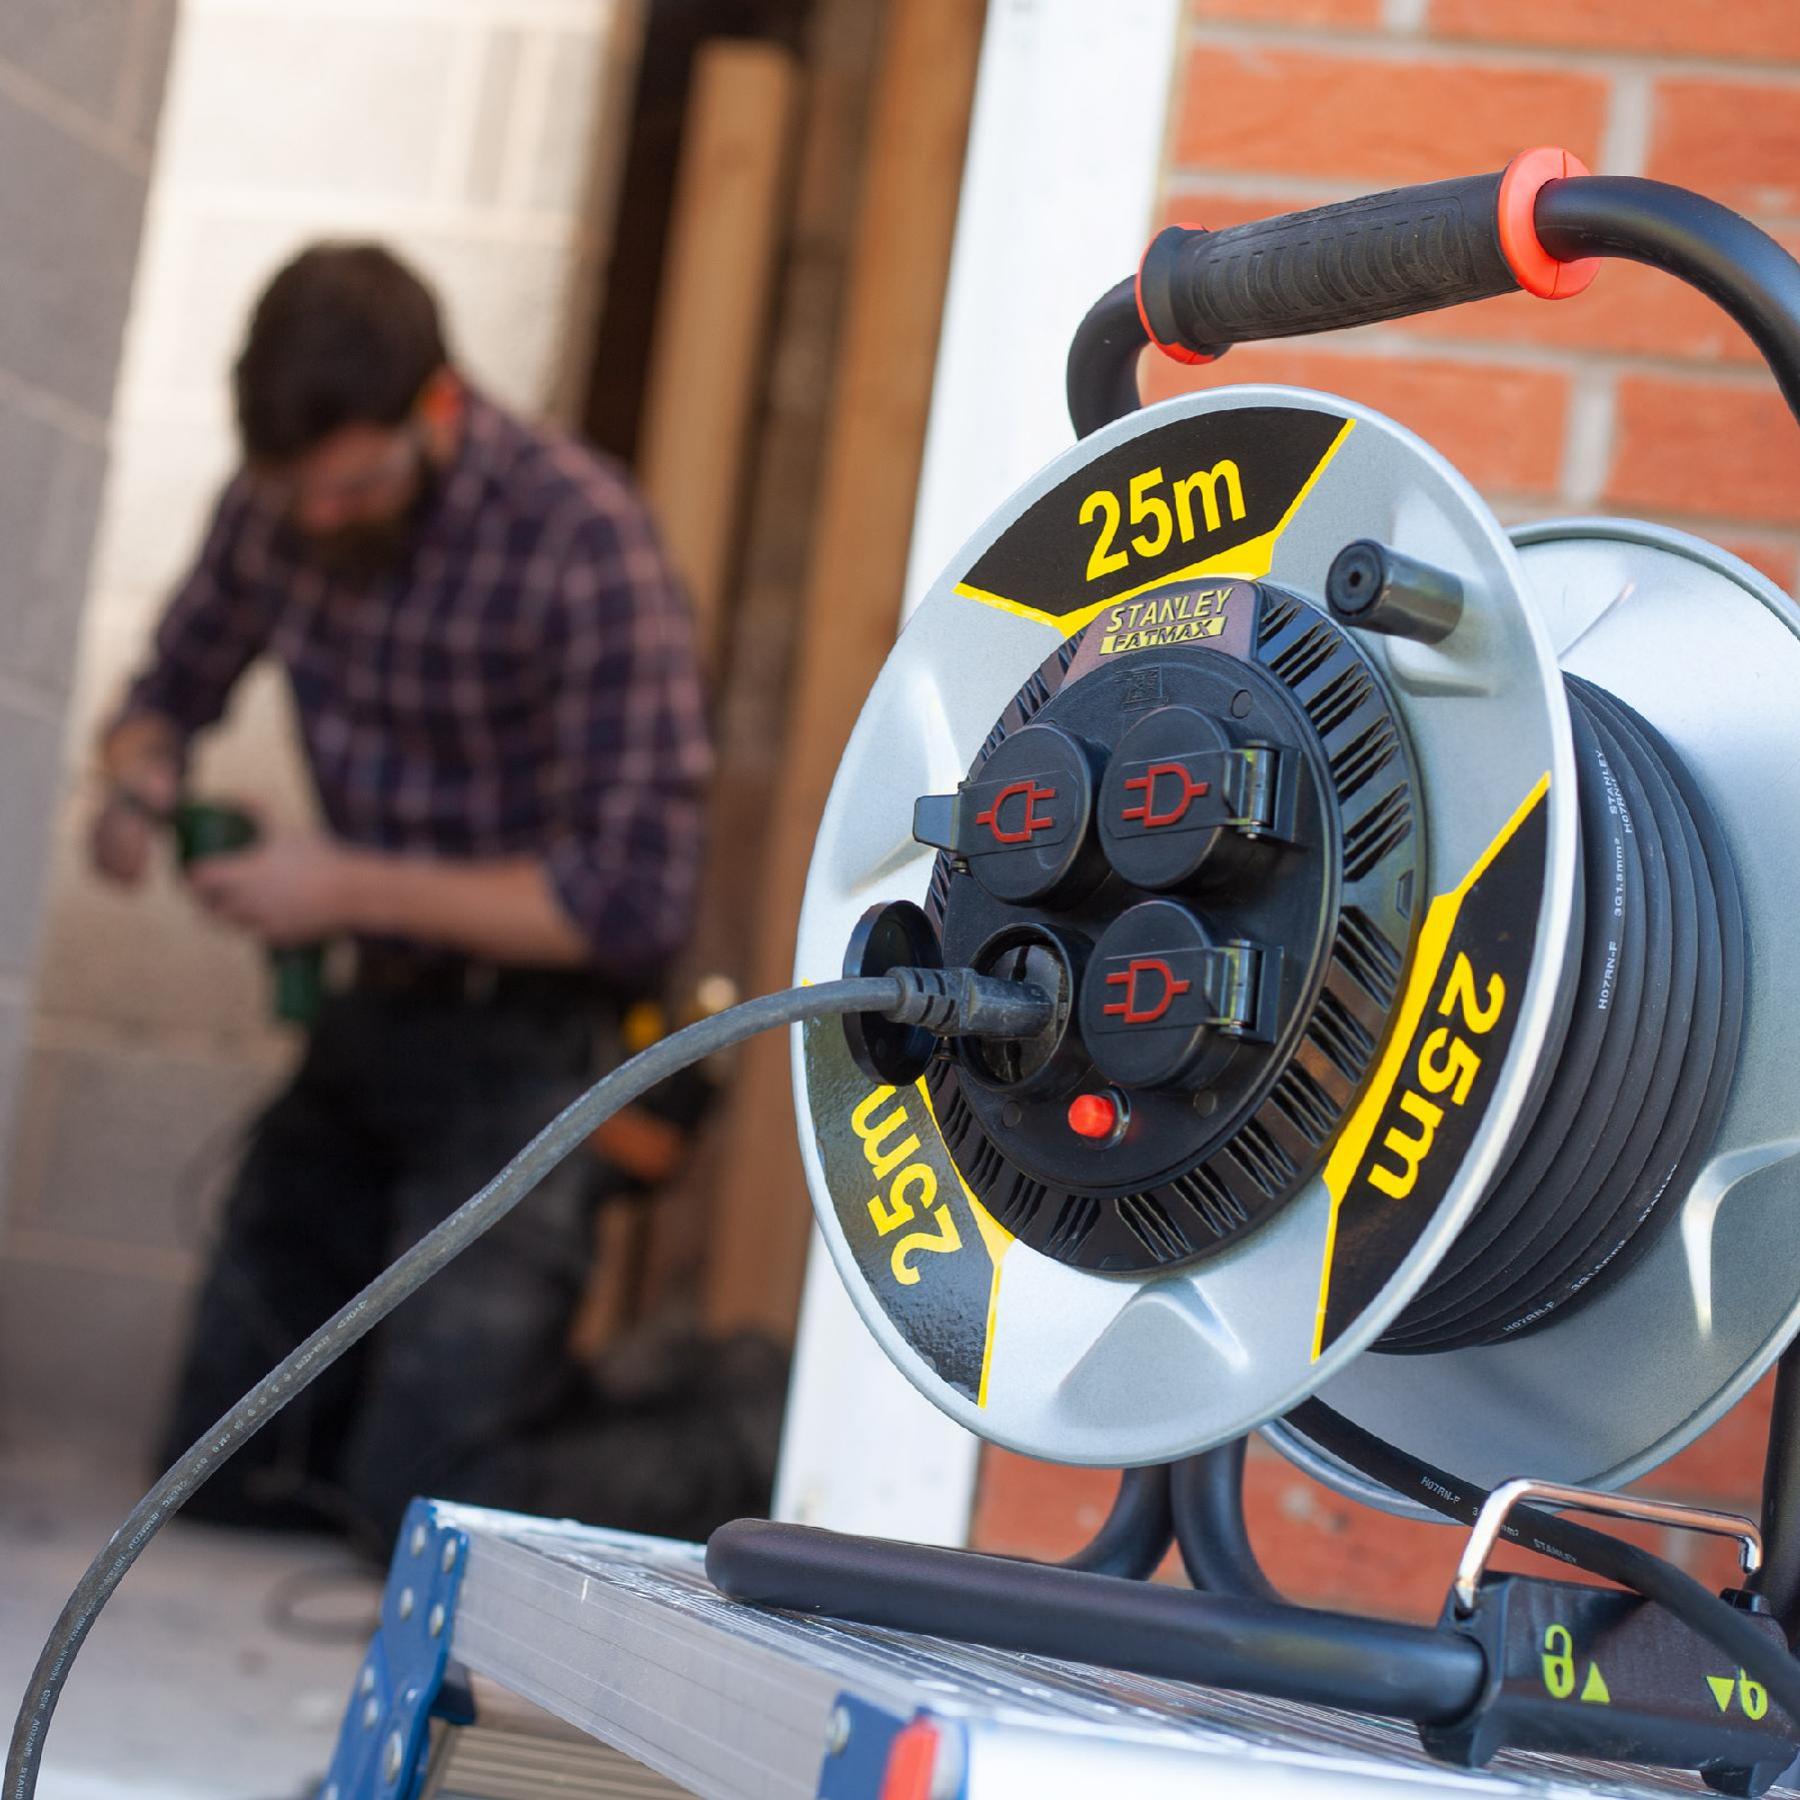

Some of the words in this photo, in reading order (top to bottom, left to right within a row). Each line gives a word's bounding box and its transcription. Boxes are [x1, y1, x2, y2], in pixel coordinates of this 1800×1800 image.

[1079, 459, 1247, 581] 25m
[1106, 587, 1235, 633] STANLEY
[1111, 619, 1214, 652] FATMAX
[1599, 941, 1618, 1010] H07RN-F
[1367, 951, 1506, 1200] 25m
[851, 1085, 963, 1286] 25m
[1419, 1475, 1461, 1505] H07RN-F
